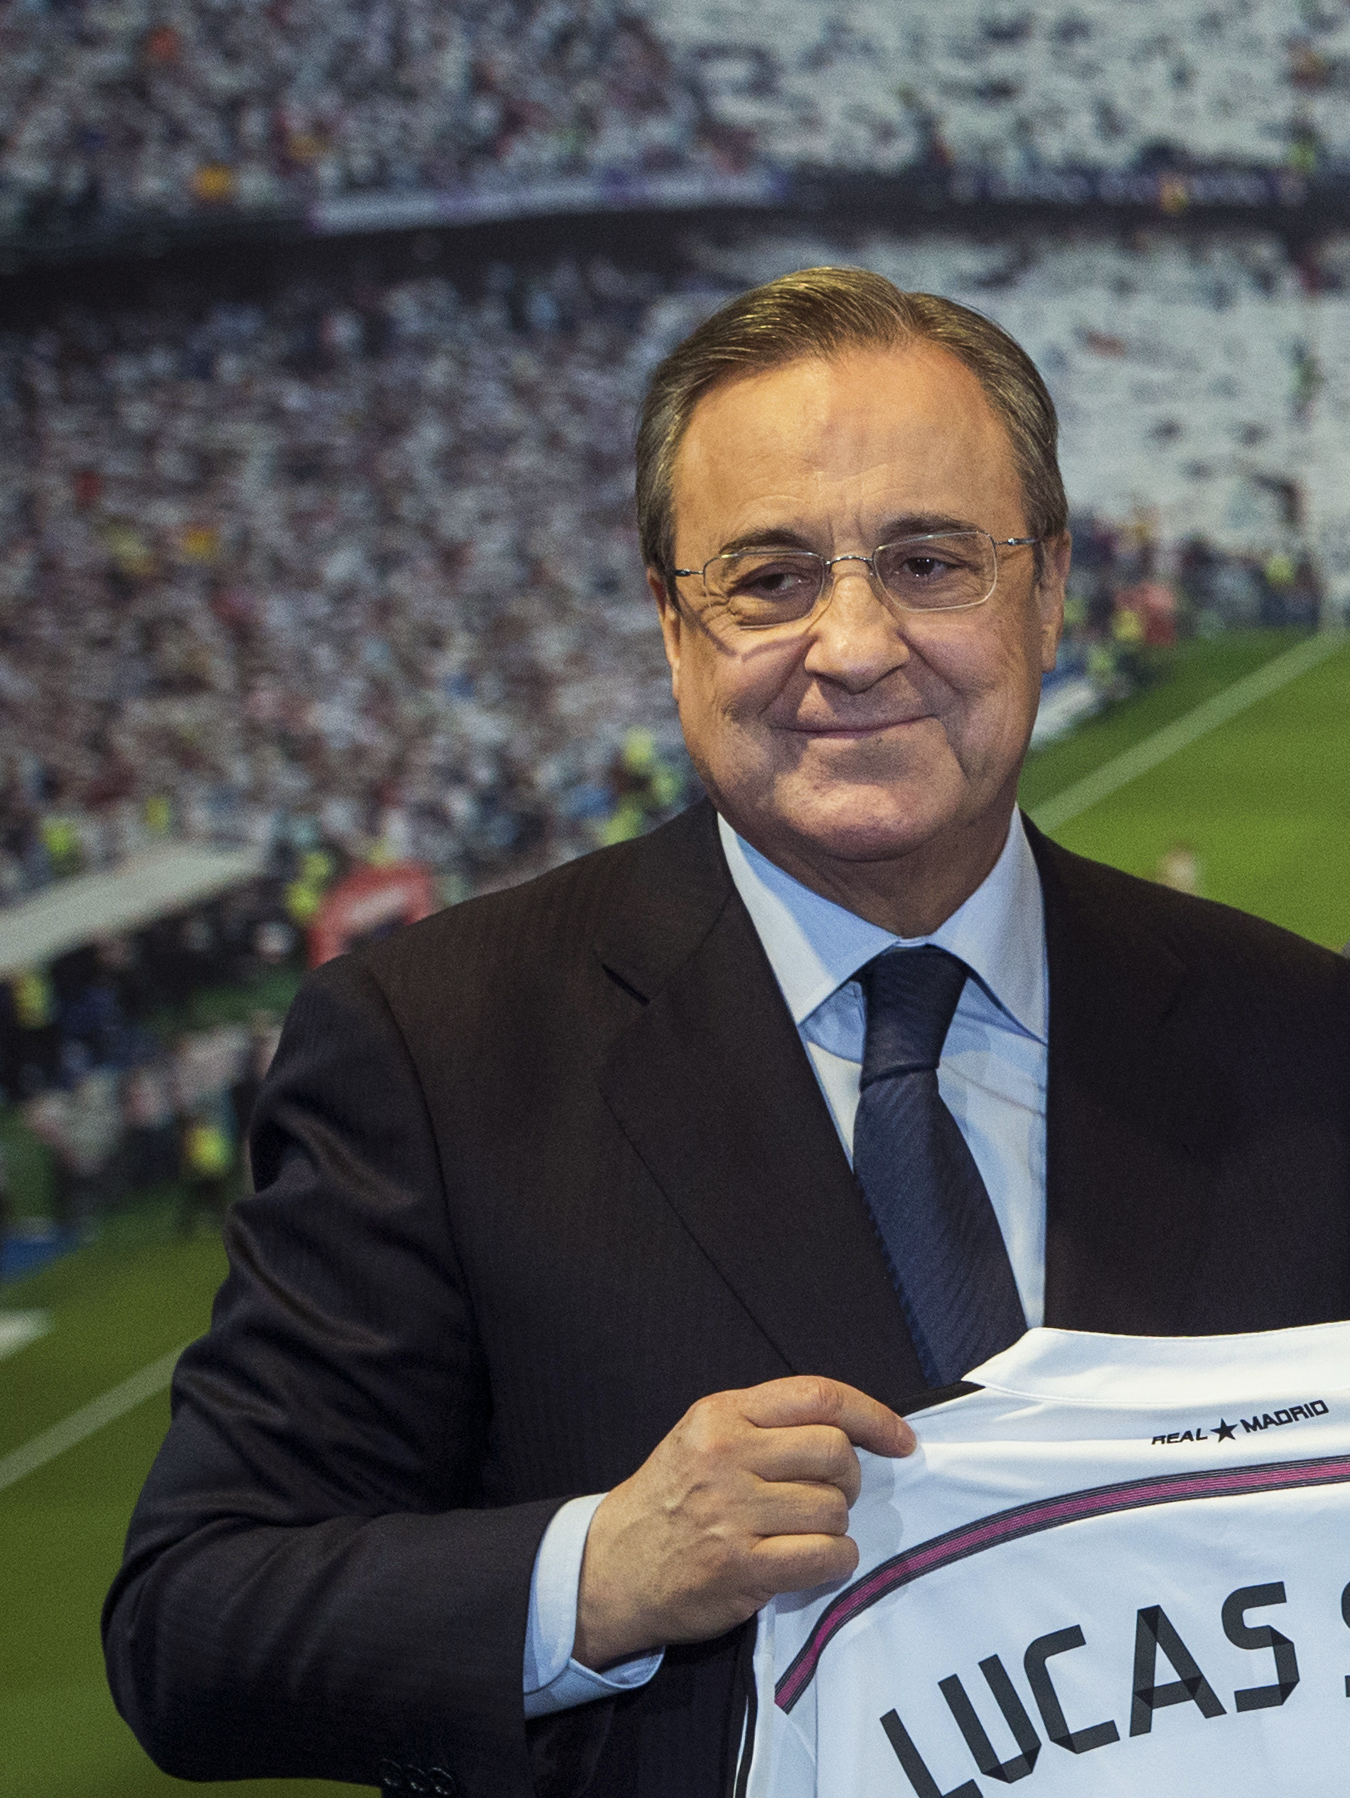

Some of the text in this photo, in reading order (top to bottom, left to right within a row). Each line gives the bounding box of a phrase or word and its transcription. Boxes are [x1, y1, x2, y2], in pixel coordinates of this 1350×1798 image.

[1151, 1399, 1329, 1445] REAL MADRID
[879, 1581, 1301, 1798] LUCAS
